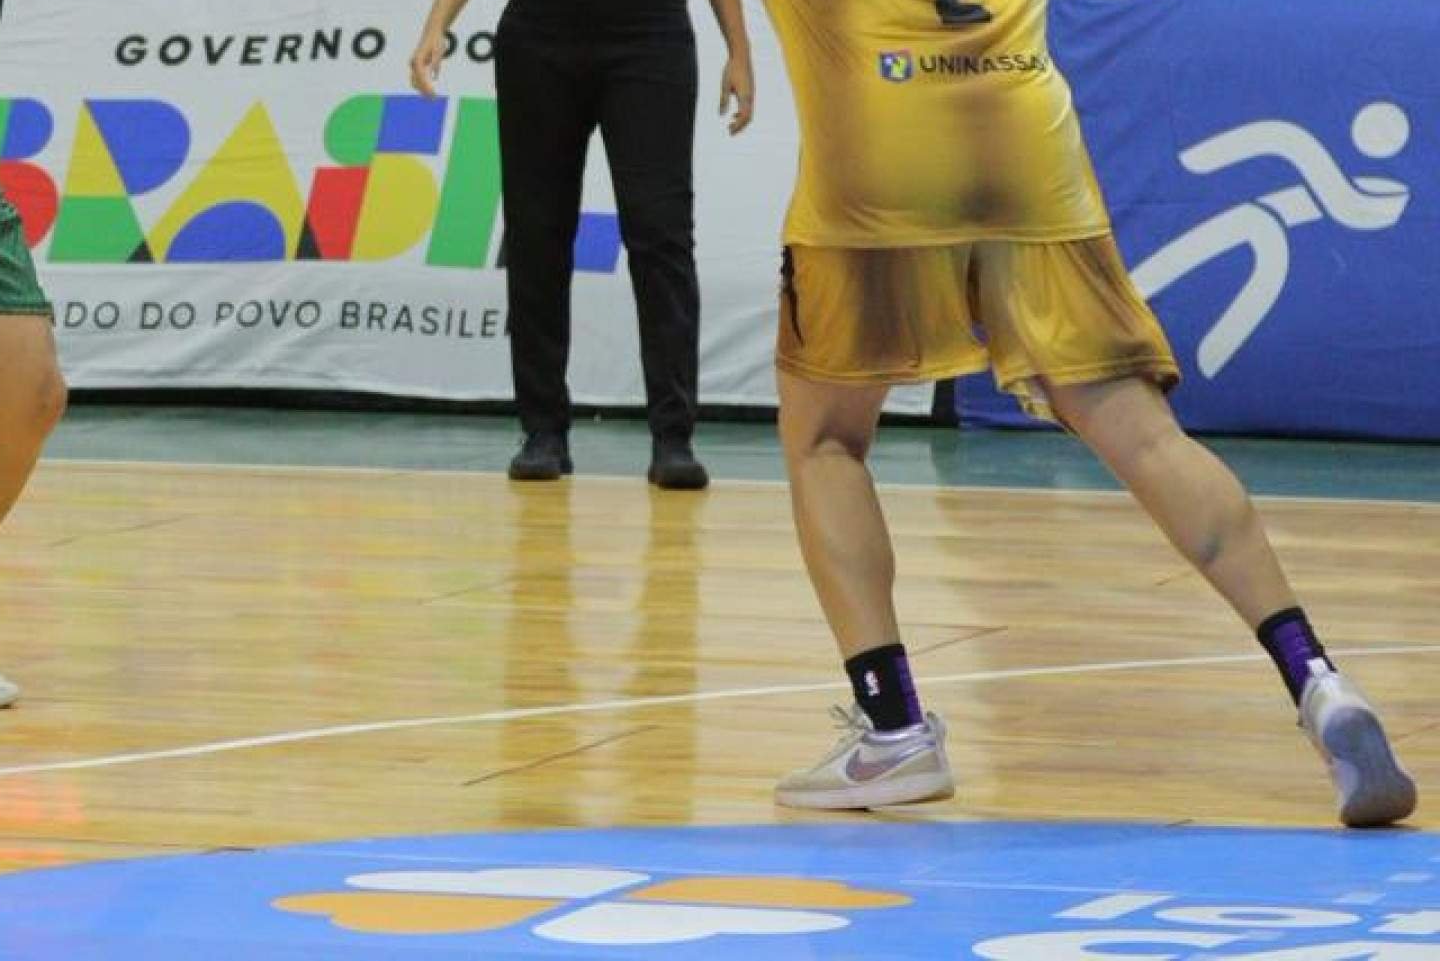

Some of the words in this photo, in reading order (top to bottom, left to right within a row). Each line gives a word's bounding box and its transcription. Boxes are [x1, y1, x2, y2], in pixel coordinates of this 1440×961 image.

[114, 28, 386, 66] GOVERNO
[139, 299, 197, 330] DO
[215, 298, 322, 330] POVO
